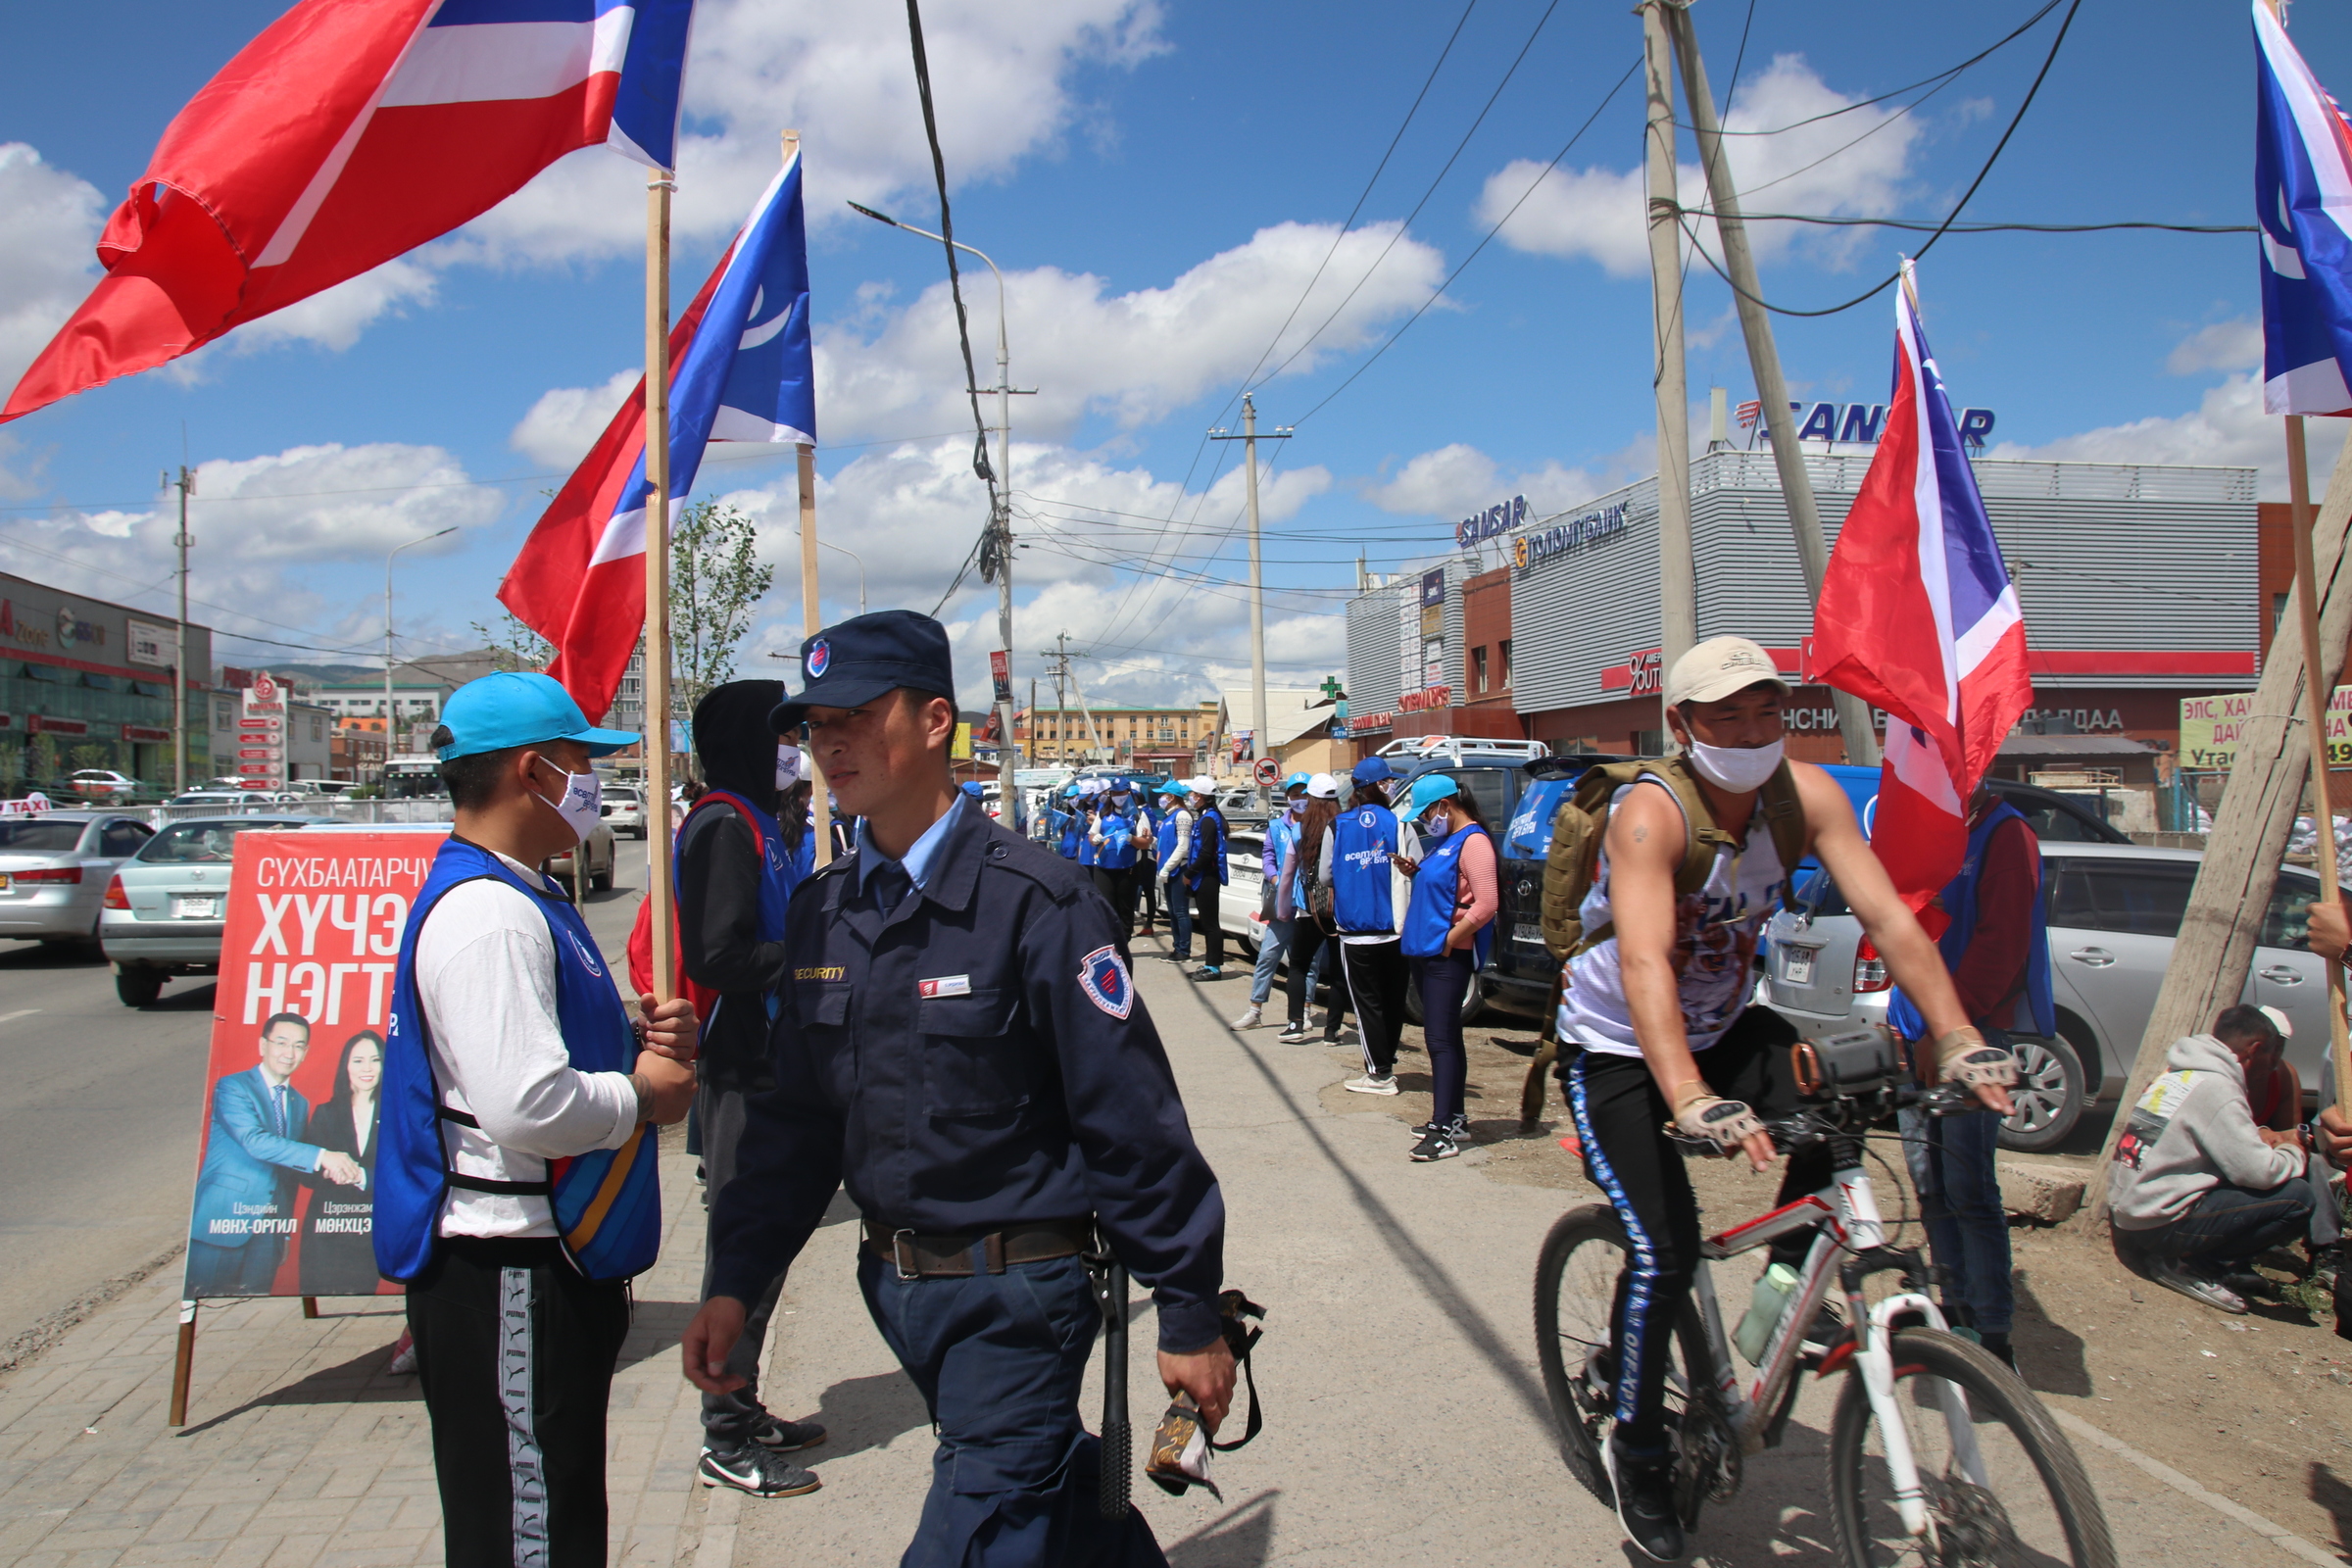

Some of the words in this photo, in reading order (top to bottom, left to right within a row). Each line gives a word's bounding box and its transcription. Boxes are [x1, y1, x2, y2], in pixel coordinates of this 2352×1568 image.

[1460, 493, 1526, 549] SANSAR
[1530, 519, 1581, 562] ГОЛОМТ
[1586, 503, 1629, 540] БАНК
[10, 800, 49, 812] TAXI
[250, 893, 408, 956] ХҮЧЭ
[795, 966, 846, 981] SECURITY
[243, 961, 395, 1025] НЭГТ
[233, 1201, 278, 1215] Цэндийн
[209, 1218, 298, 1235] МӨНХ-ОРГИЛ
[506, 1310, 525, 1319] PUMA
[506, 1348, 526, 1357] PUMA
[506, 1389, 525, 1397] PUMA
